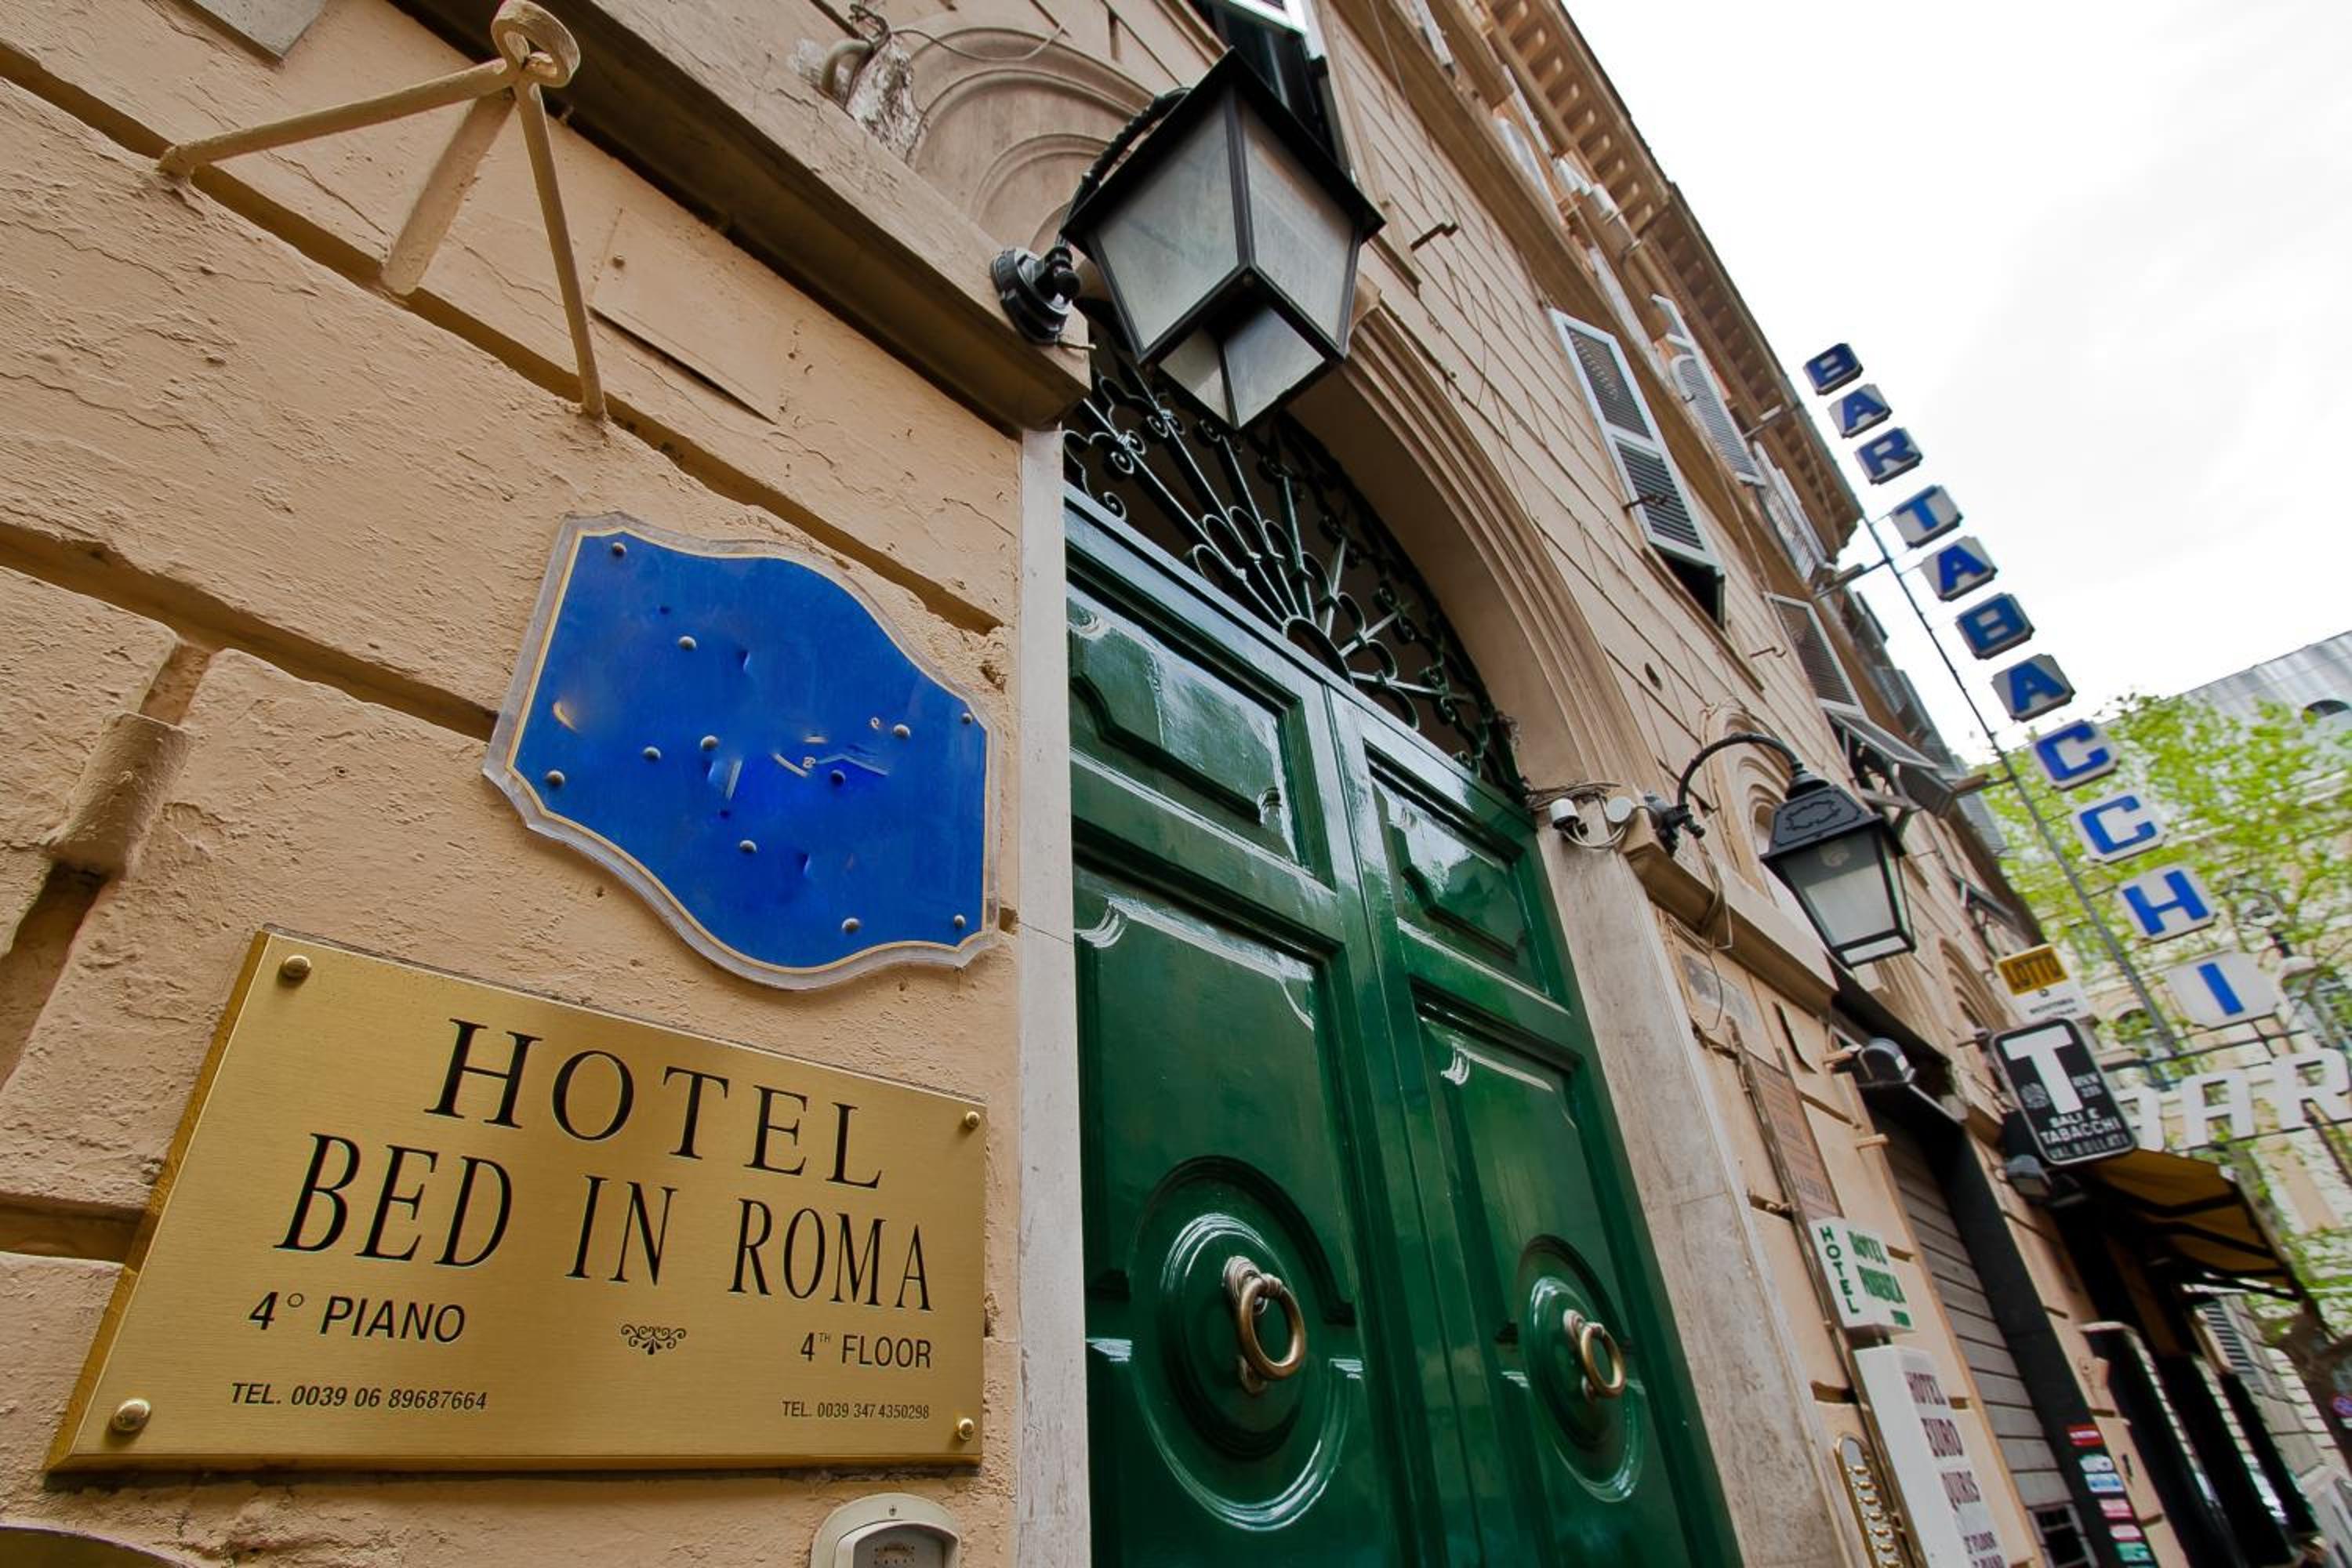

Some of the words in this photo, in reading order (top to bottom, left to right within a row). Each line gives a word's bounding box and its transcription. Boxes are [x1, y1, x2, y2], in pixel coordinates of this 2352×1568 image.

[1807, 343, 1915, 475] BAR
[1894, 485, 2245, 1017] TABACCHI
[2002, 949, 2067, 991] LOTTO
[2002, 1025, 2083, 1114] T
[424, 1018, 881, 1189] HOTEL
[2039, 1116, 2122, 1145] TABACCHI
[273, 1133, 513, 1268] BED
[565, 1174, 678, 1286] IN
[728, 1198, 933, 1312] ROMA
[1819, 1225, 1860, 1314] HOTEL
[319, 1295, 466, 1343] PIANO
[841, 1334, 931, 1368] FLOOR
[231, 1382, 281, 1405] TEL.
[291, 1385, 347, 1406] 0039
[354, 1388, 382, 1408] 06
[388, 1388, 488, 1410] 89687664
[782, 1401, 812, 1417] TEL.
[817, 1402, 849, 1418] 0039
